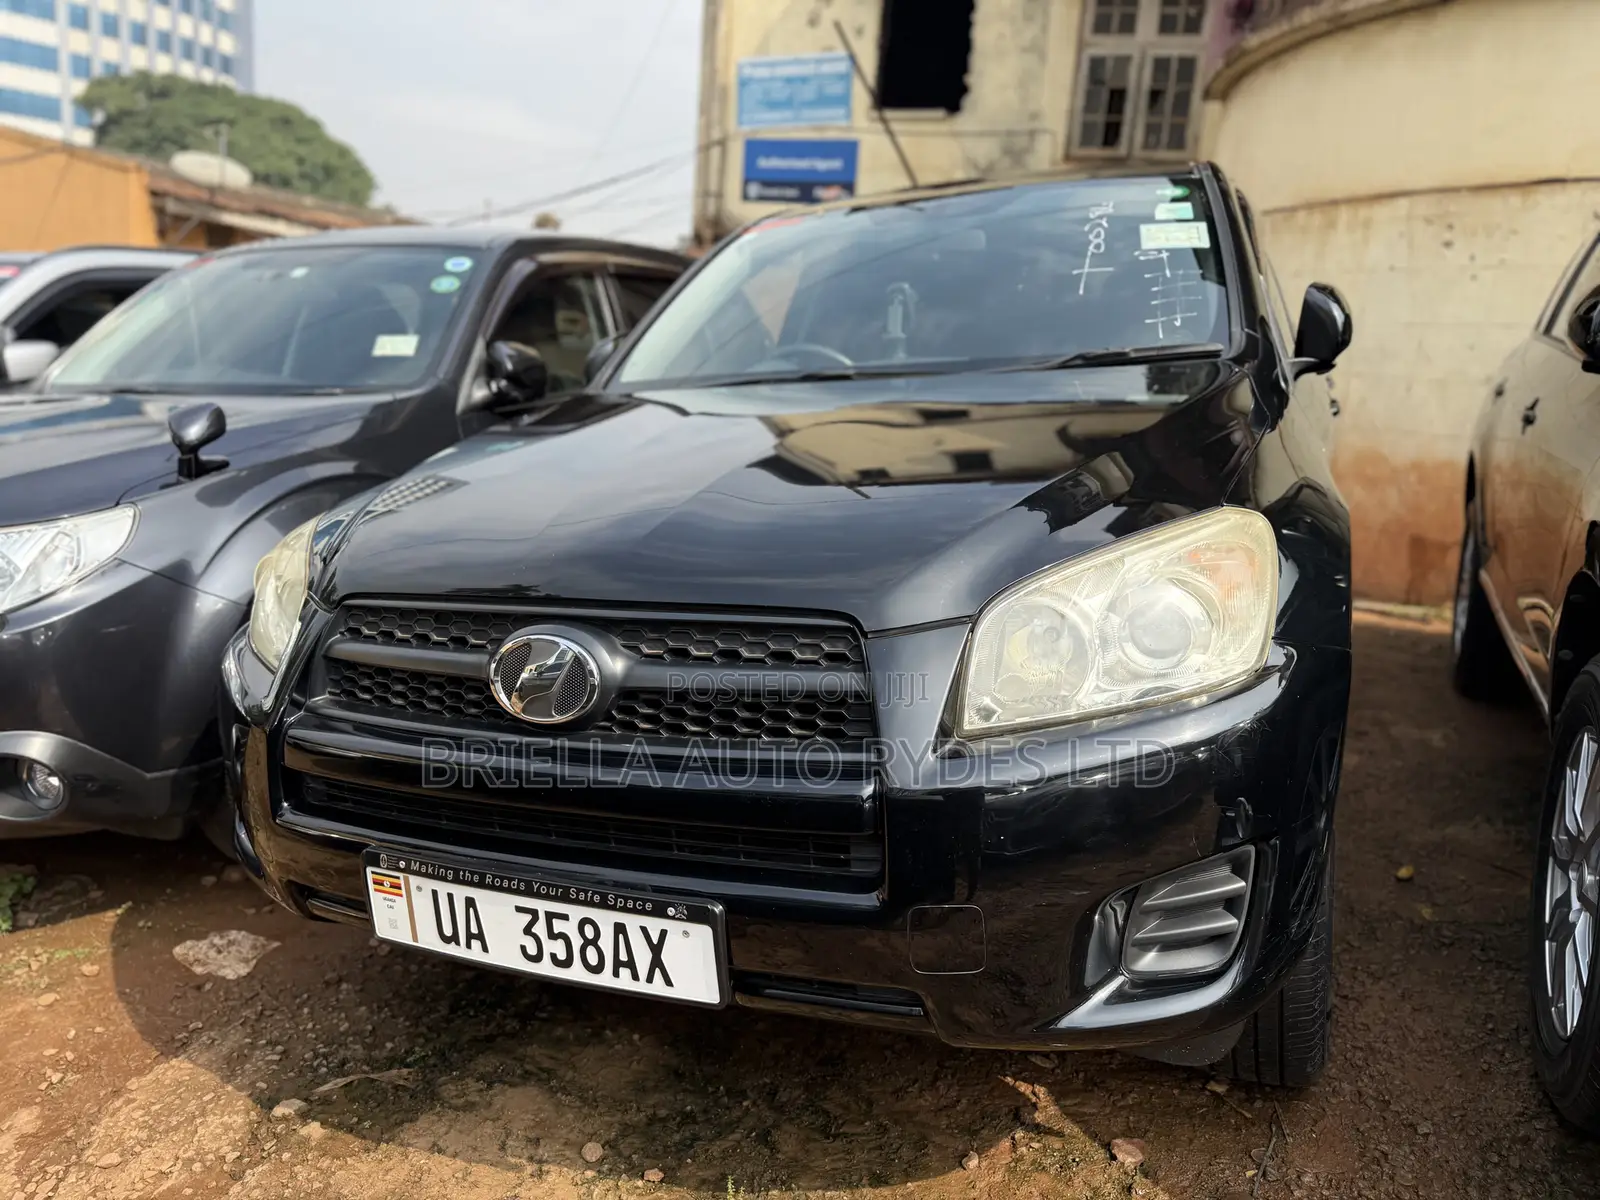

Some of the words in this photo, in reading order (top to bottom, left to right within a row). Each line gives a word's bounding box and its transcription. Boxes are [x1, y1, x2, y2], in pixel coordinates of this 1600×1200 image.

[410, 860, 454, 880] Making
[460, 870, 480, 883] the
[485, 874, 526, 890] Roads
[532, 881, 563, 896] Your
[569, 887, 601, 903] Safe
[607, 894, 653, 911] Space
[431, 888, 489, 954] UA
[514, 904, 675, 988] 358AX
